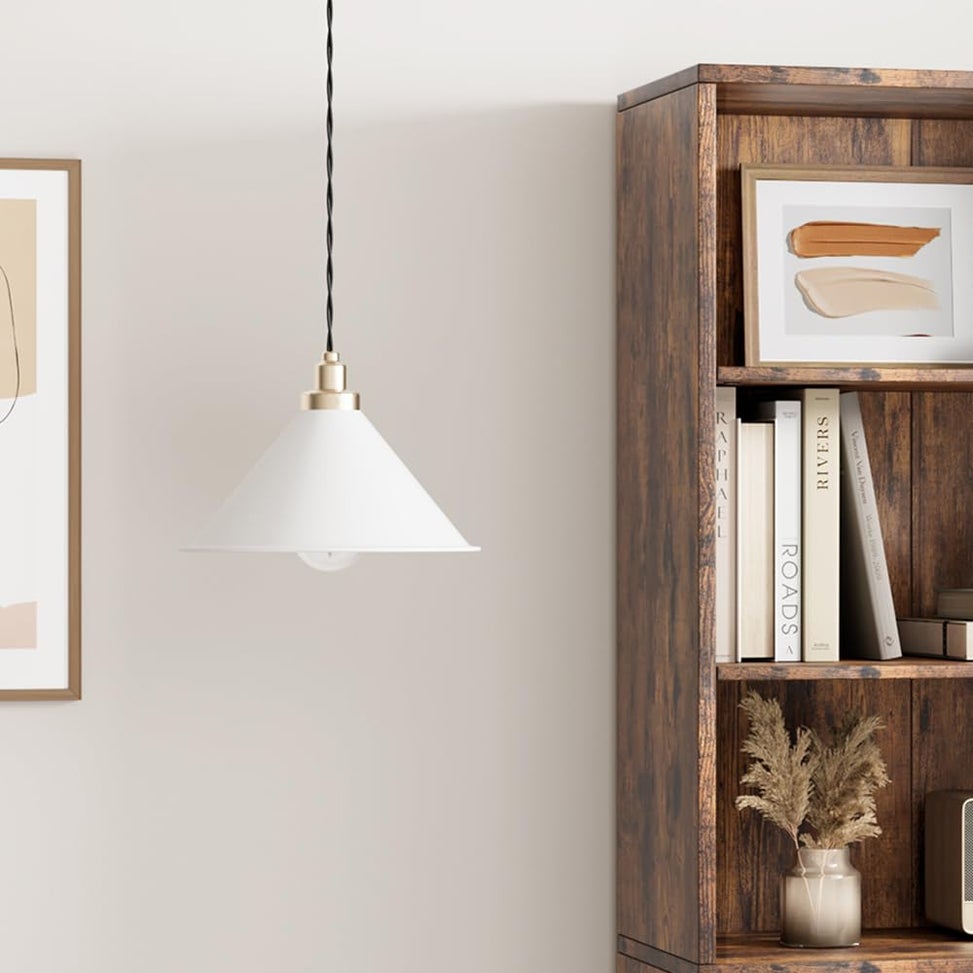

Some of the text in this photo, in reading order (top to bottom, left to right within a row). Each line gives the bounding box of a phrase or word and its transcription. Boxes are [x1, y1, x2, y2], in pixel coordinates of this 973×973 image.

[716, 411, 728, 538] RAPHAEL
[816, 416, 829, 490] RIVERS
[781, 544, 799, 636] ROADS
